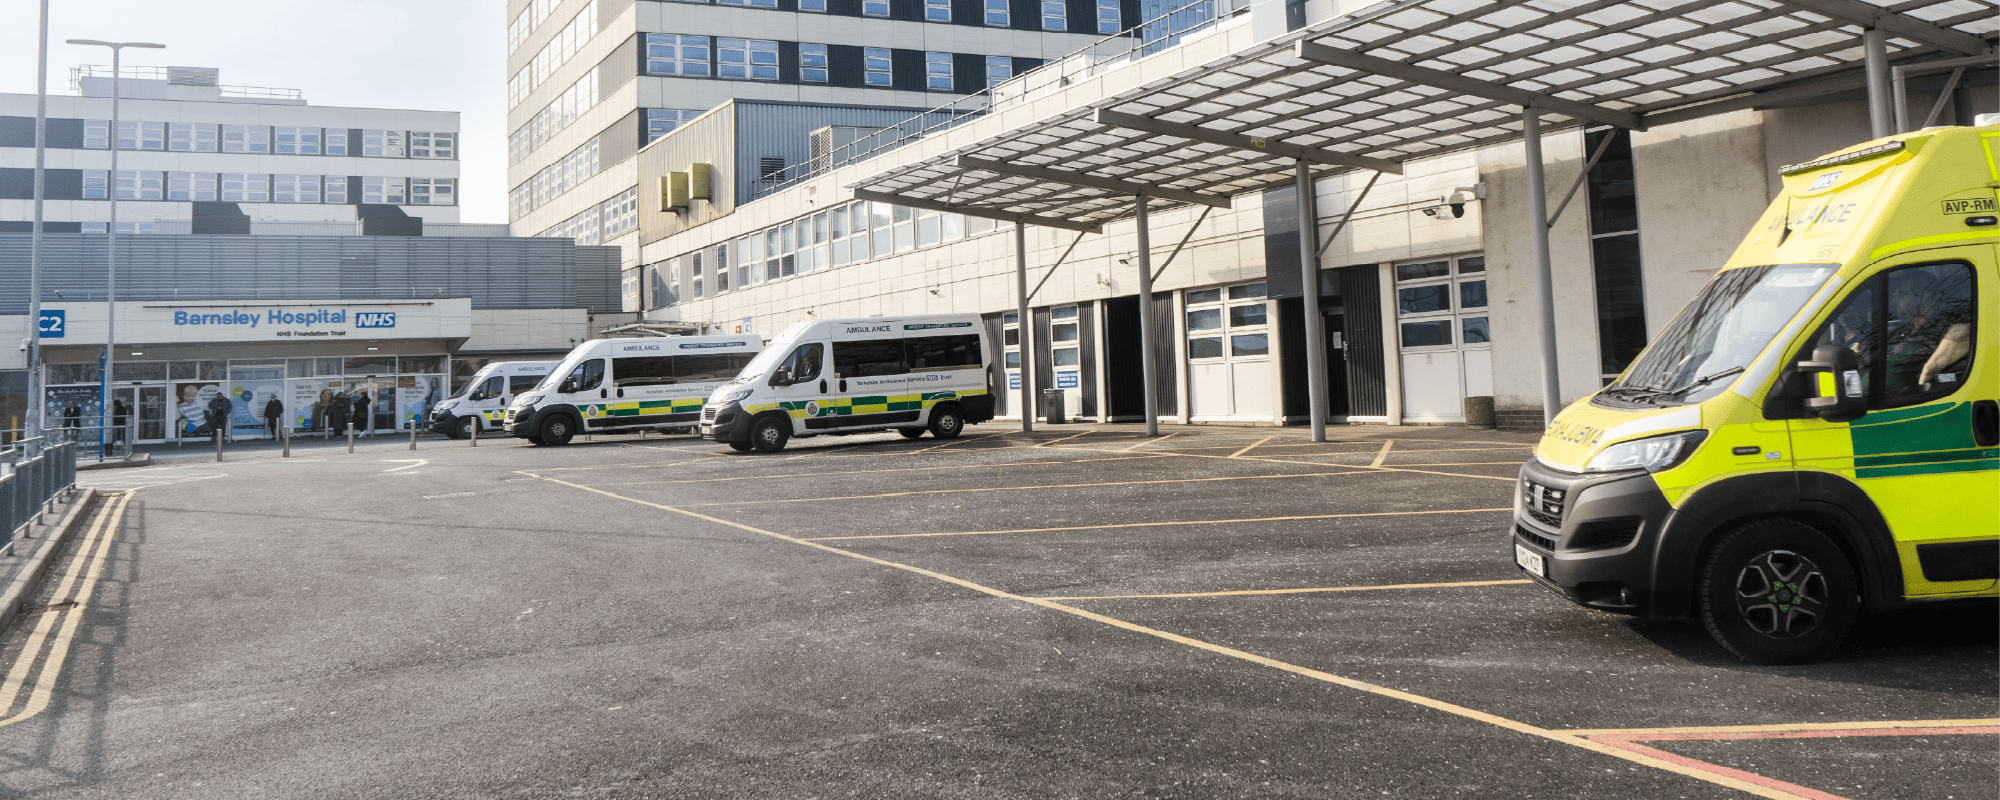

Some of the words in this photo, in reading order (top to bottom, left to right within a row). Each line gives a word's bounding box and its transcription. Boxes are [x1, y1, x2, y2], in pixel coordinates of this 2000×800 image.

[1946, 199, 1995, 212] AVP-RM
[39, 316, 62, 332] C2
[174, 310, 260, 328] Barnsley
[268, 309, 346, 327] Hospital
[357, 313, 395, 327] NHS
[846, 325, 891, 334] AMBULANCE
